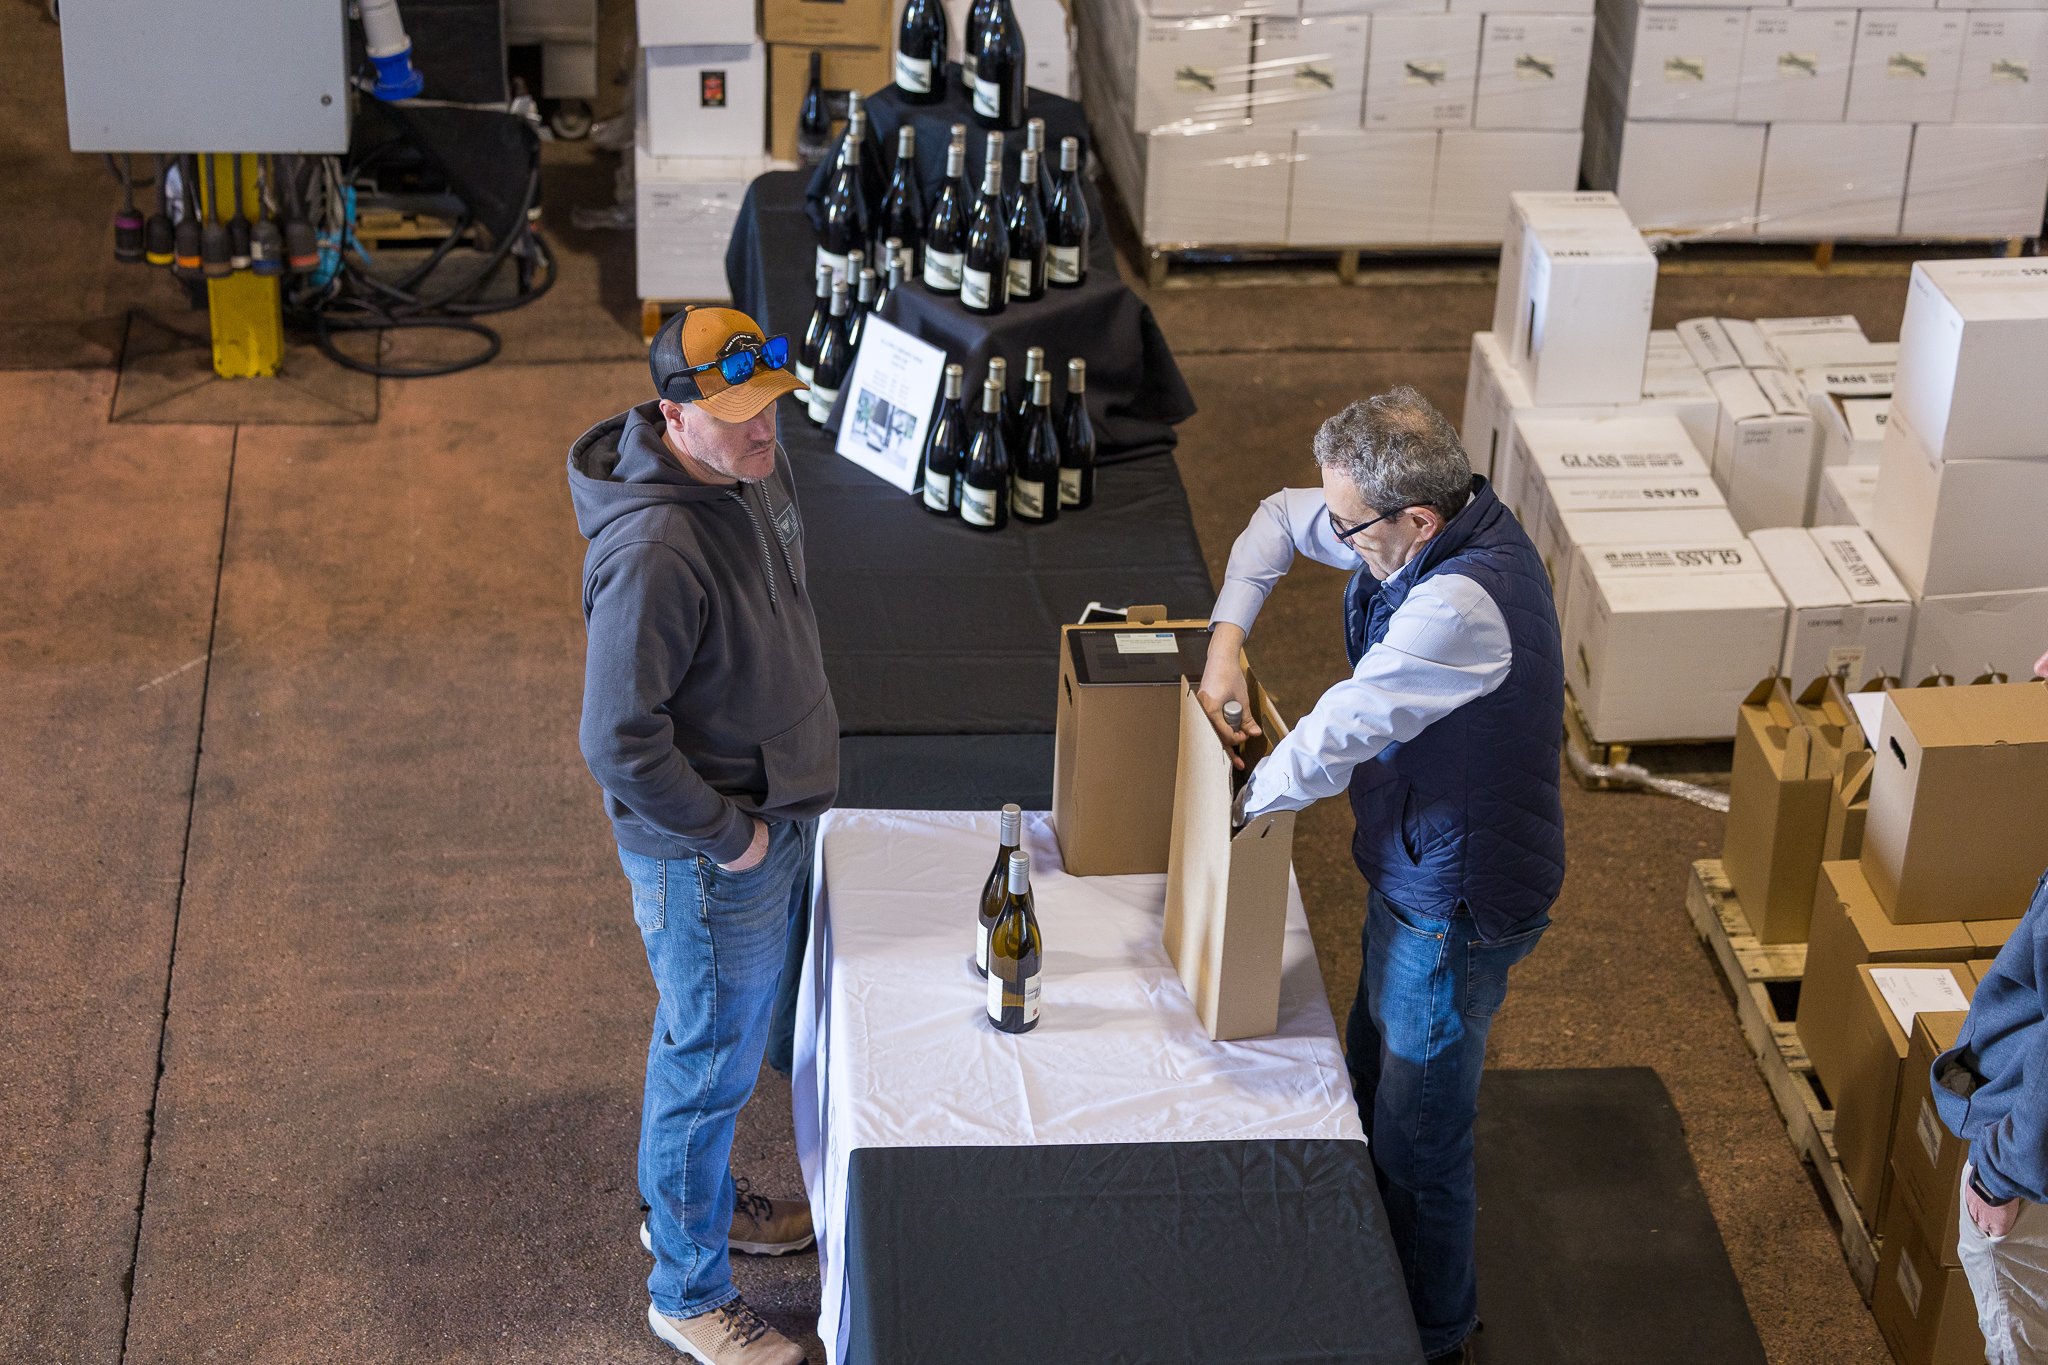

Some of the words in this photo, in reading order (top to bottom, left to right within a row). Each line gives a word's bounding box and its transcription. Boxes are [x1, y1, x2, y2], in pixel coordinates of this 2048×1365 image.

[1561, 453, 1621, 468] GLASS
[1643, 487, 1700, 499] GLASS
[1674, 548, 1742, 566] GLASS
